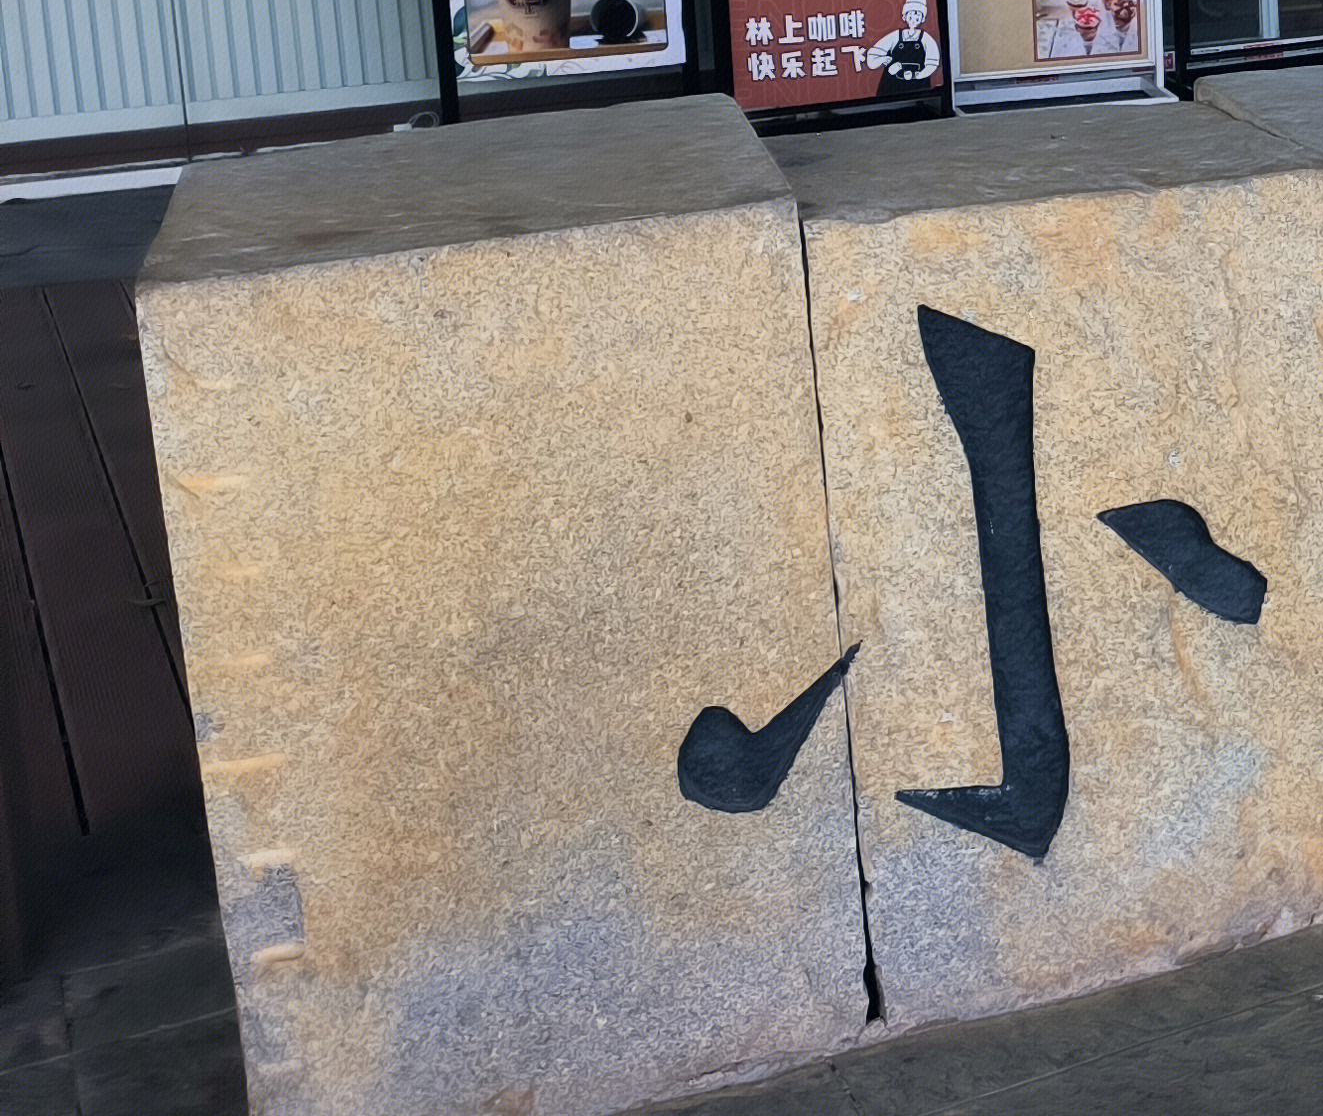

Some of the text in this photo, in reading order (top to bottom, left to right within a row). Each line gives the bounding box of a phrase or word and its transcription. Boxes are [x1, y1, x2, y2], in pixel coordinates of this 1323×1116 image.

[745, 9, 866, 47] 林上咖啡
[747, 44, 868, 82] 快乐起飞
